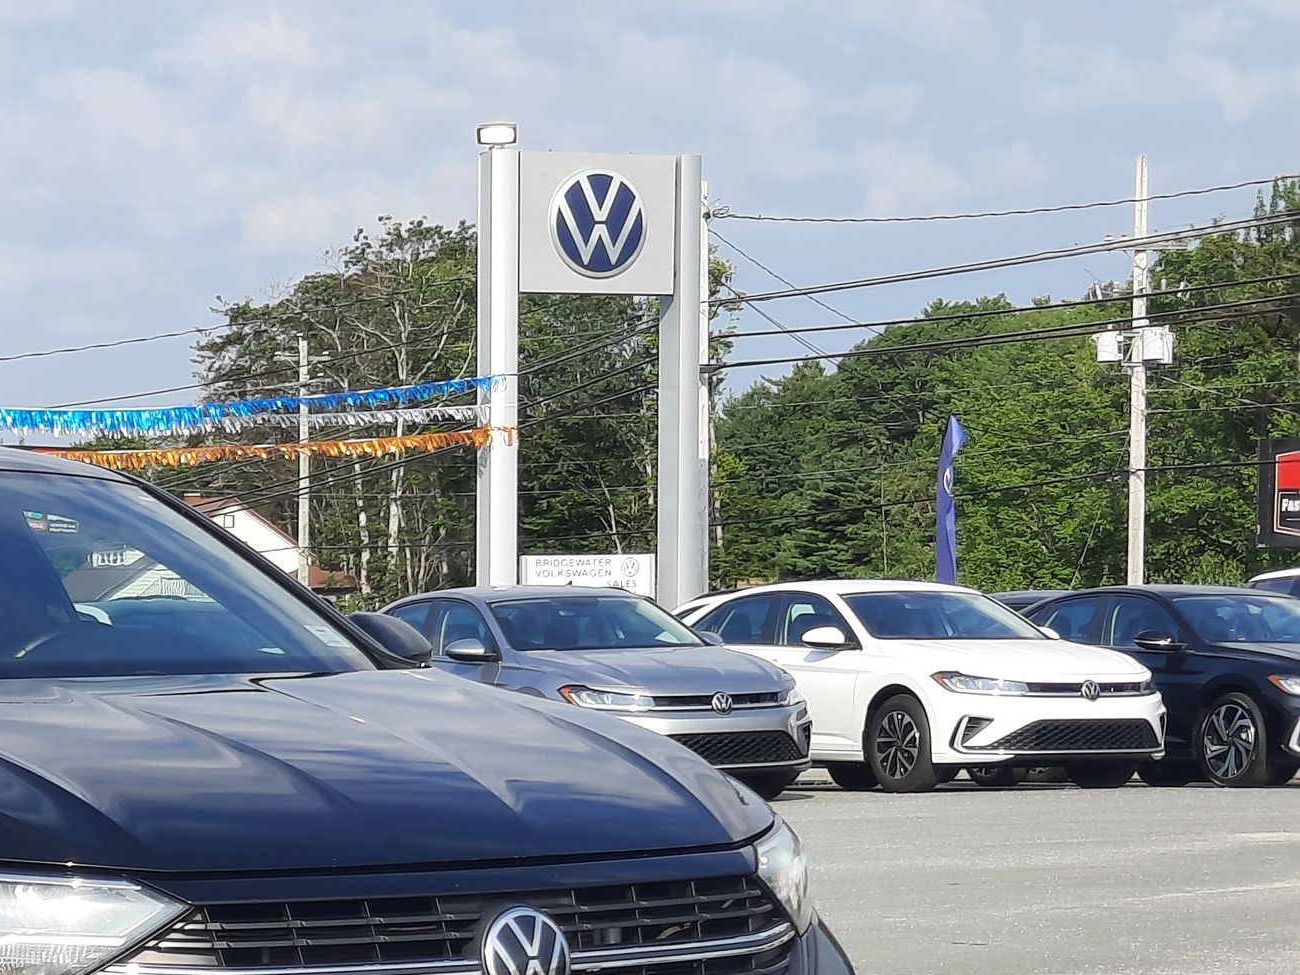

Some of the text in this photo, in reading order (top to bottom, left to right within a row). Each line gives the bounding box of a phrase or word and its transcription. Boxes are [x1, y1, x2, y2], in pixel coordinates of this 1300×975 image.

[549, 169, 647, 279] VW
[535, 559, 611, 567] BRIDGEWATER
[535, 569, 612, 578] VOLKSWAGEN
[606, 579, 637, 588] SALES
